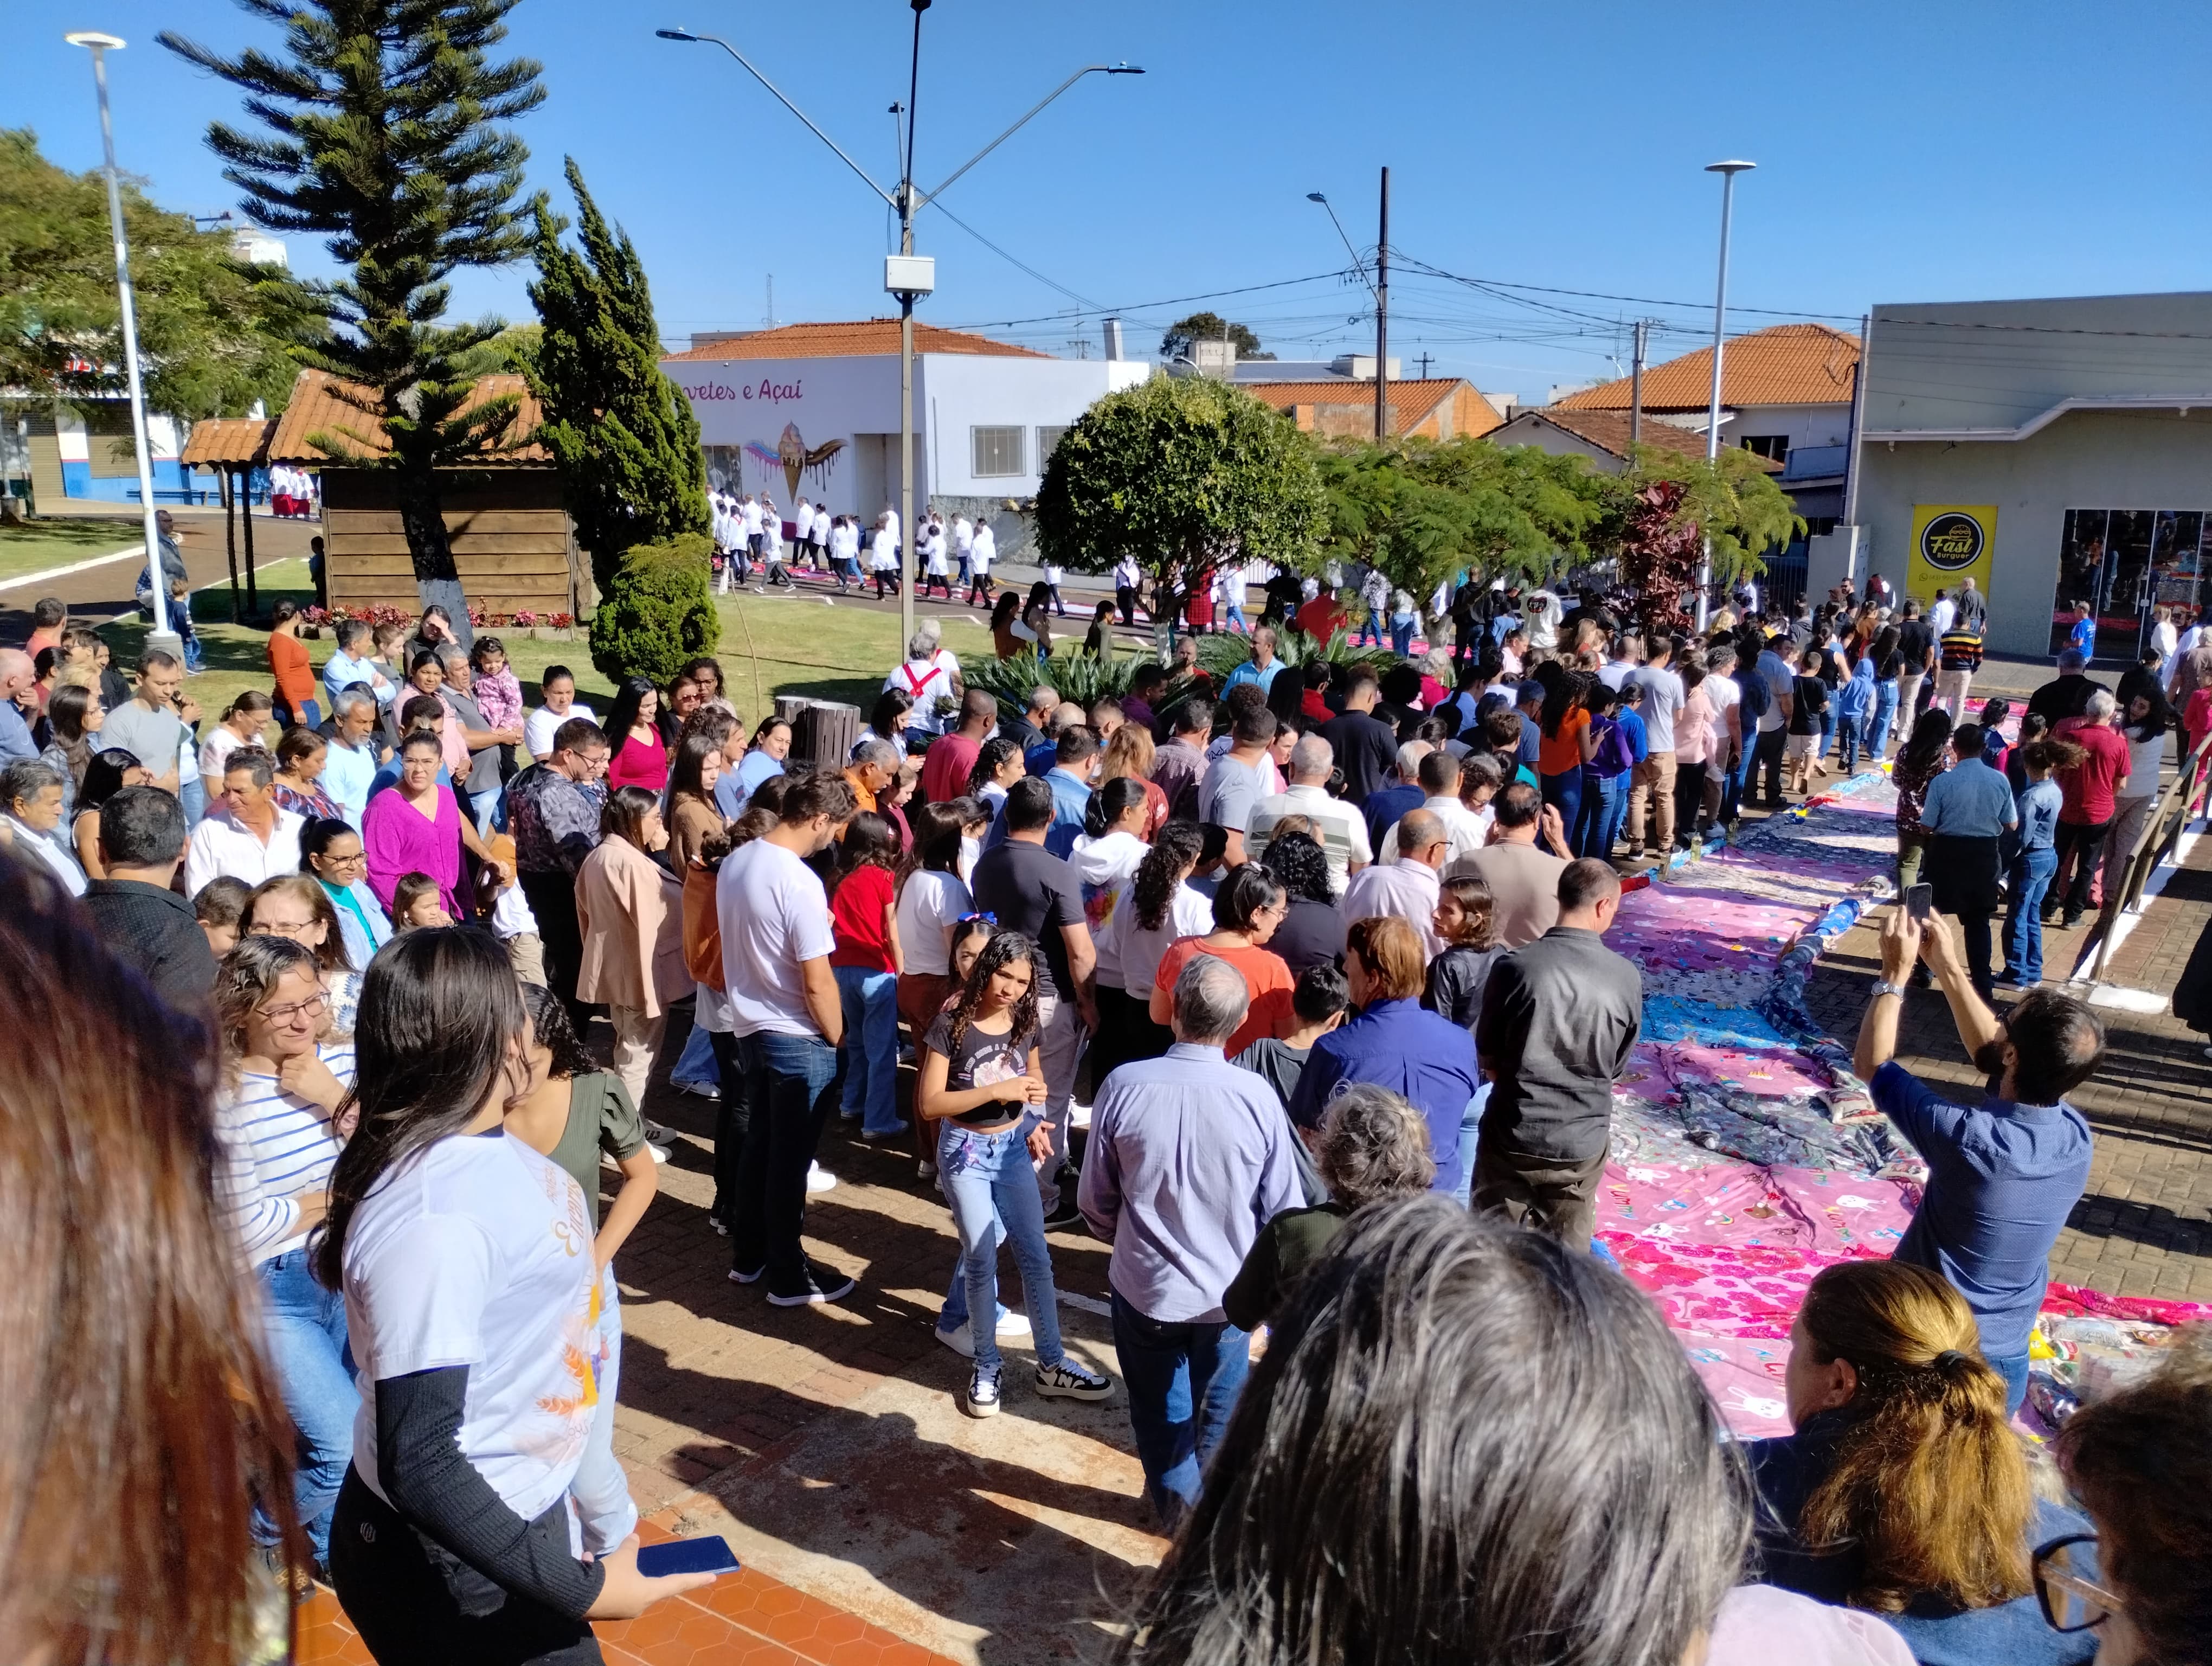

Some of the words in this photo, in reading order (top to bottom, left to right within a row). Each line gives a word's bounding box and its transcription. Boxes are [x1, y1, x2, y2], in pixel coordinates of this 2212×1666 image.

[683, 381, 736, 400] vetes
[743, 385, 753, 400] e
[758, 379, 803, 405] Açaí
[1930, 535, 1974, 554] Fast
